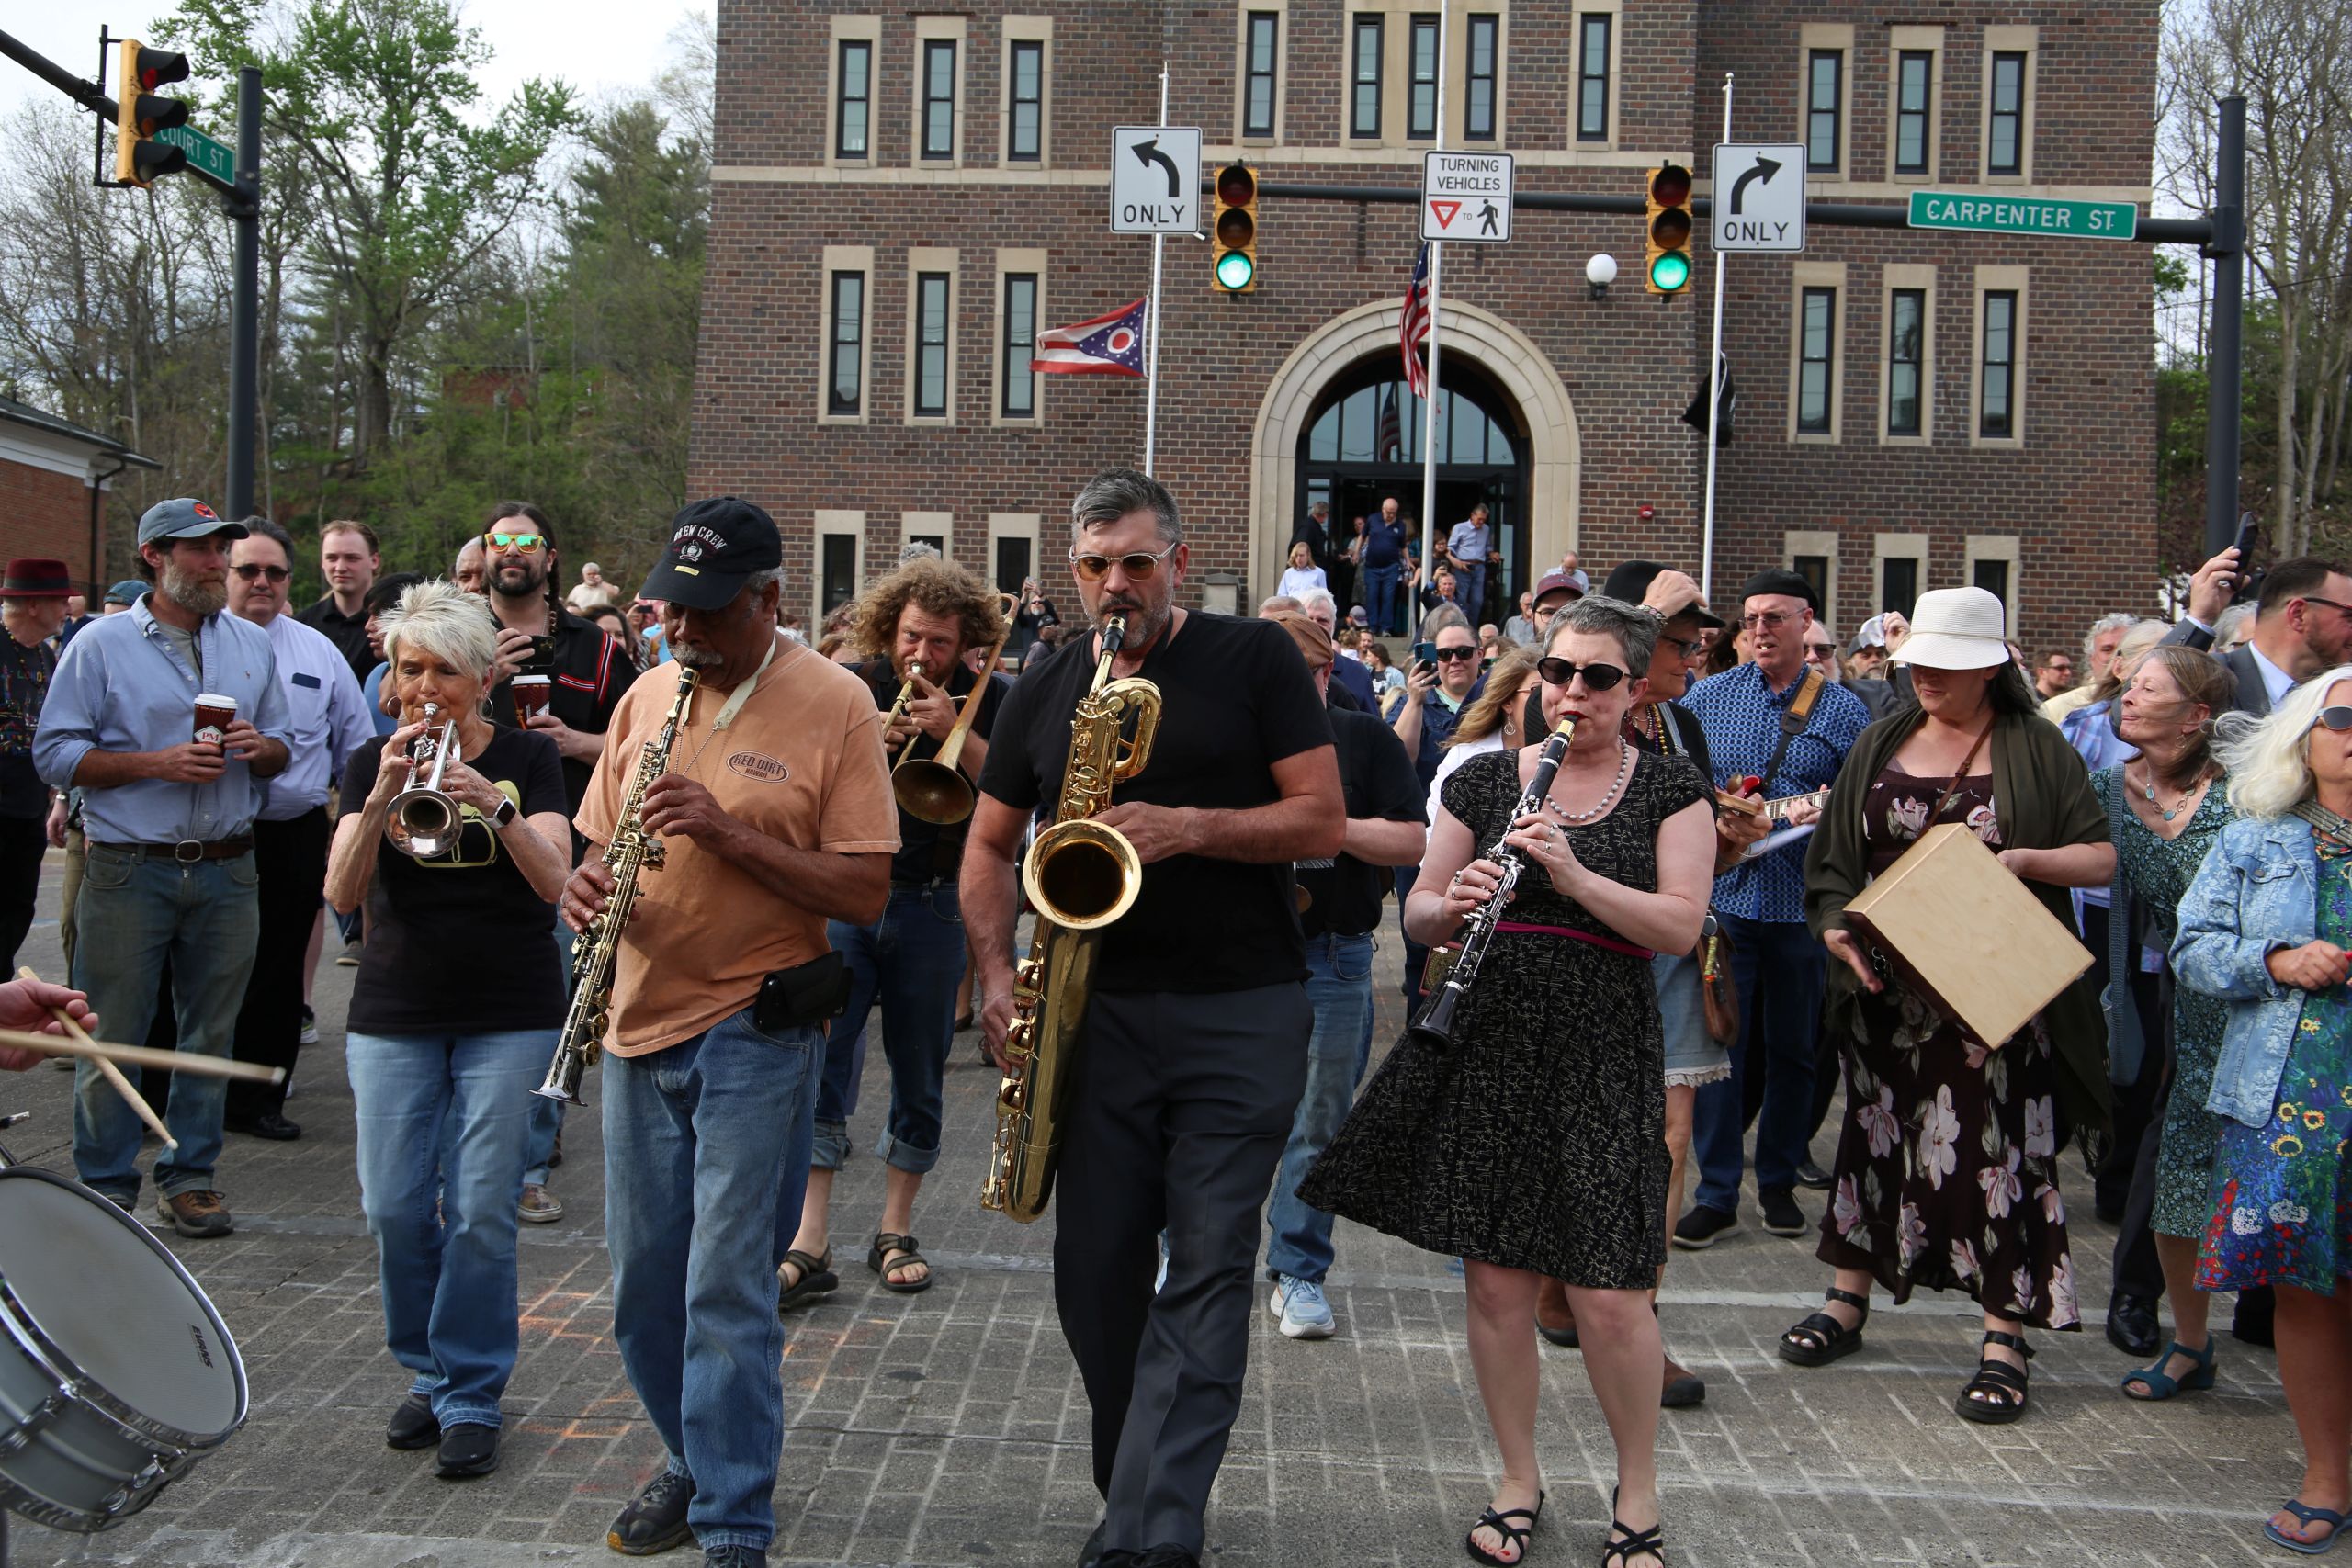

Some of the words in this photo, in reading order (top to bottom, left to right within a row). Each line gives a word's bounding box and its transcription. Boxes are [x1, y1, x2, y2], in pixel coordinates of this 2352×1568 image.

[159, 127, 202, 160] COURT
[209, 147, 224, 172] ST
[1440, 157, 1499, 173] TURNING
[1437, 175, 1501, 191] VEHICLES
[1123, 204, 1186, 223] ONLY
[1463, 212, 1473, 220] TO
[1926, 199, 2070, 229] CARPENTER
[2087, 209, 2116, 231] ST
[1724, 221, 1789, 242] ONLY
[698, 526, 728, 550] CREW
[202, 731, 220, 742] PM
[733, 754, 755, 767] RED
[756, 759, 784, 775] DIRT
[745, 767, 768, 779] HAWAII
[191, 1325, 214, 1369] EVANS
